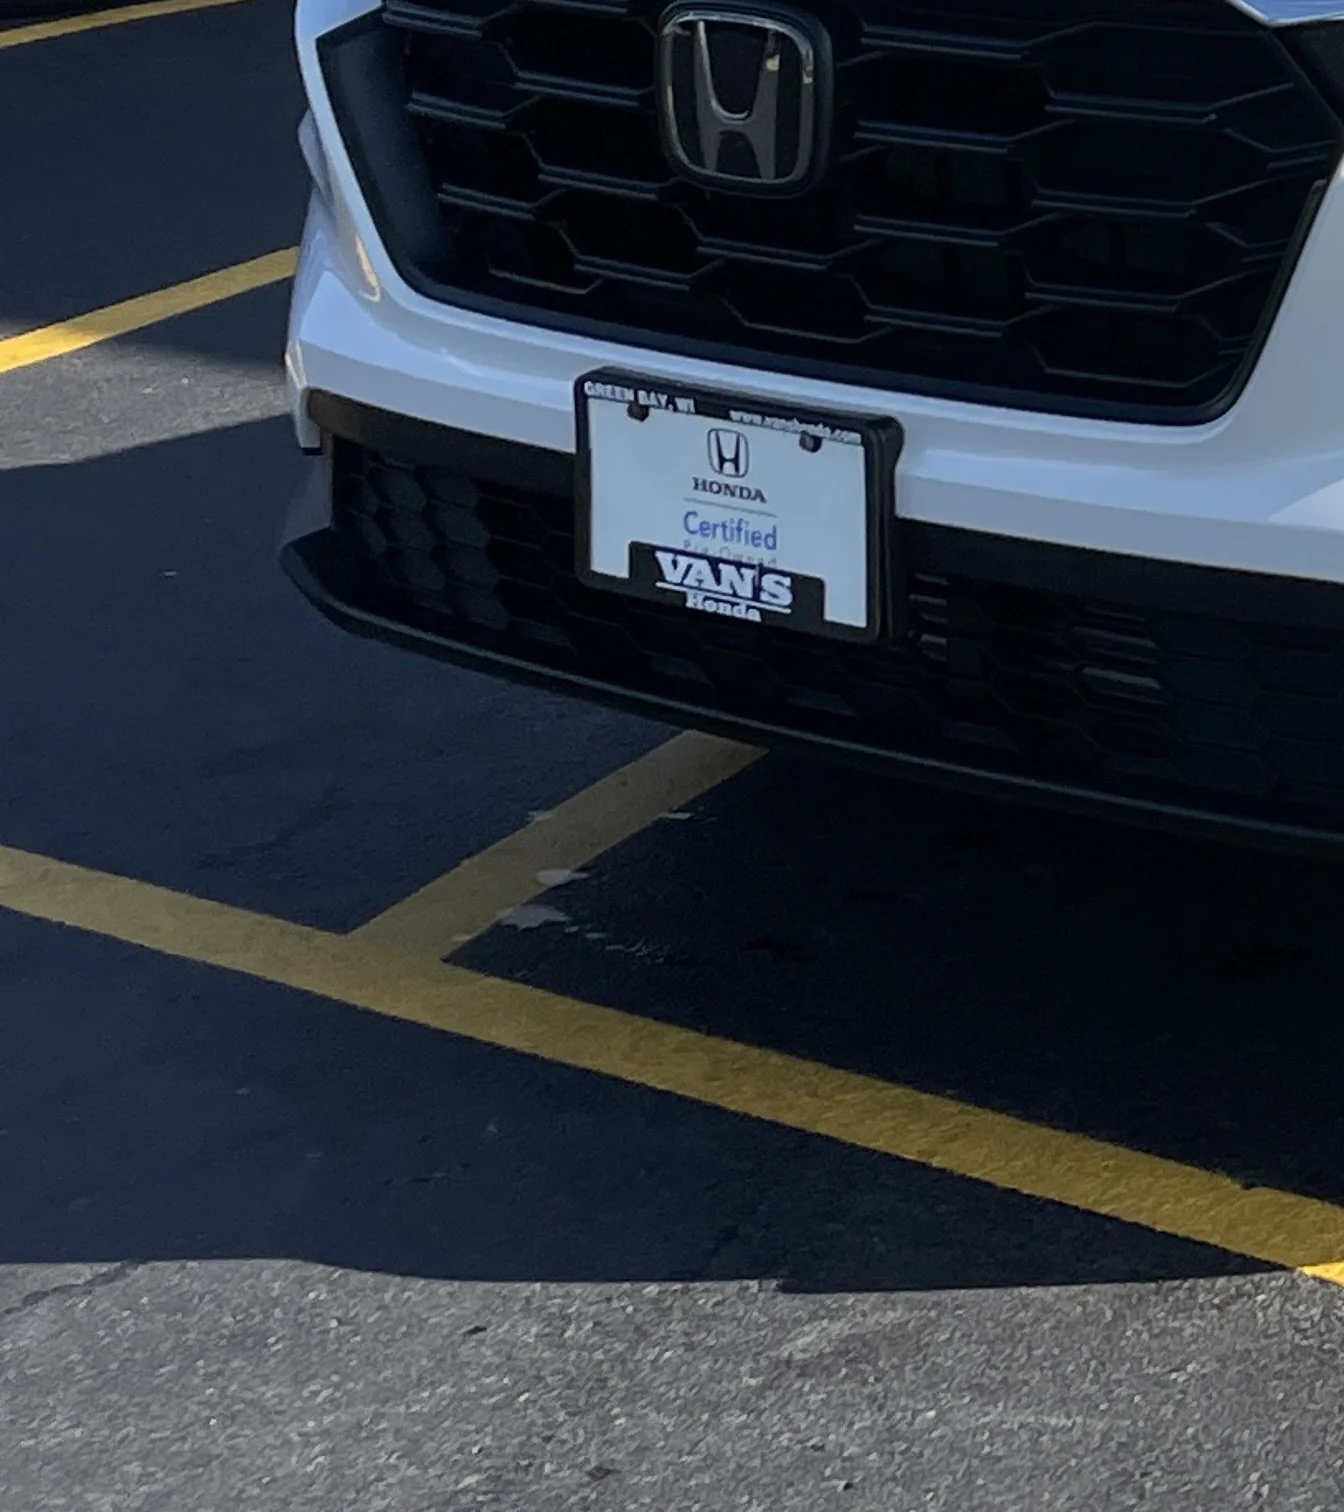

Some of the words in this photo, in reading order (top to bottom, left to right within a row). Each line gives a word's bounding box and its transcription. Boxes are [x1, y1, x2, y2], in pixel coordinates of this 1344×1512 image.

[584, 381, 635, 402] GREEN
[692, 477, 767, 505] HONDA
[683, 510, 778, 551] Certified
[655, 551, 793, 607] VAN'S
[685, 591, 762, 623] Honda
